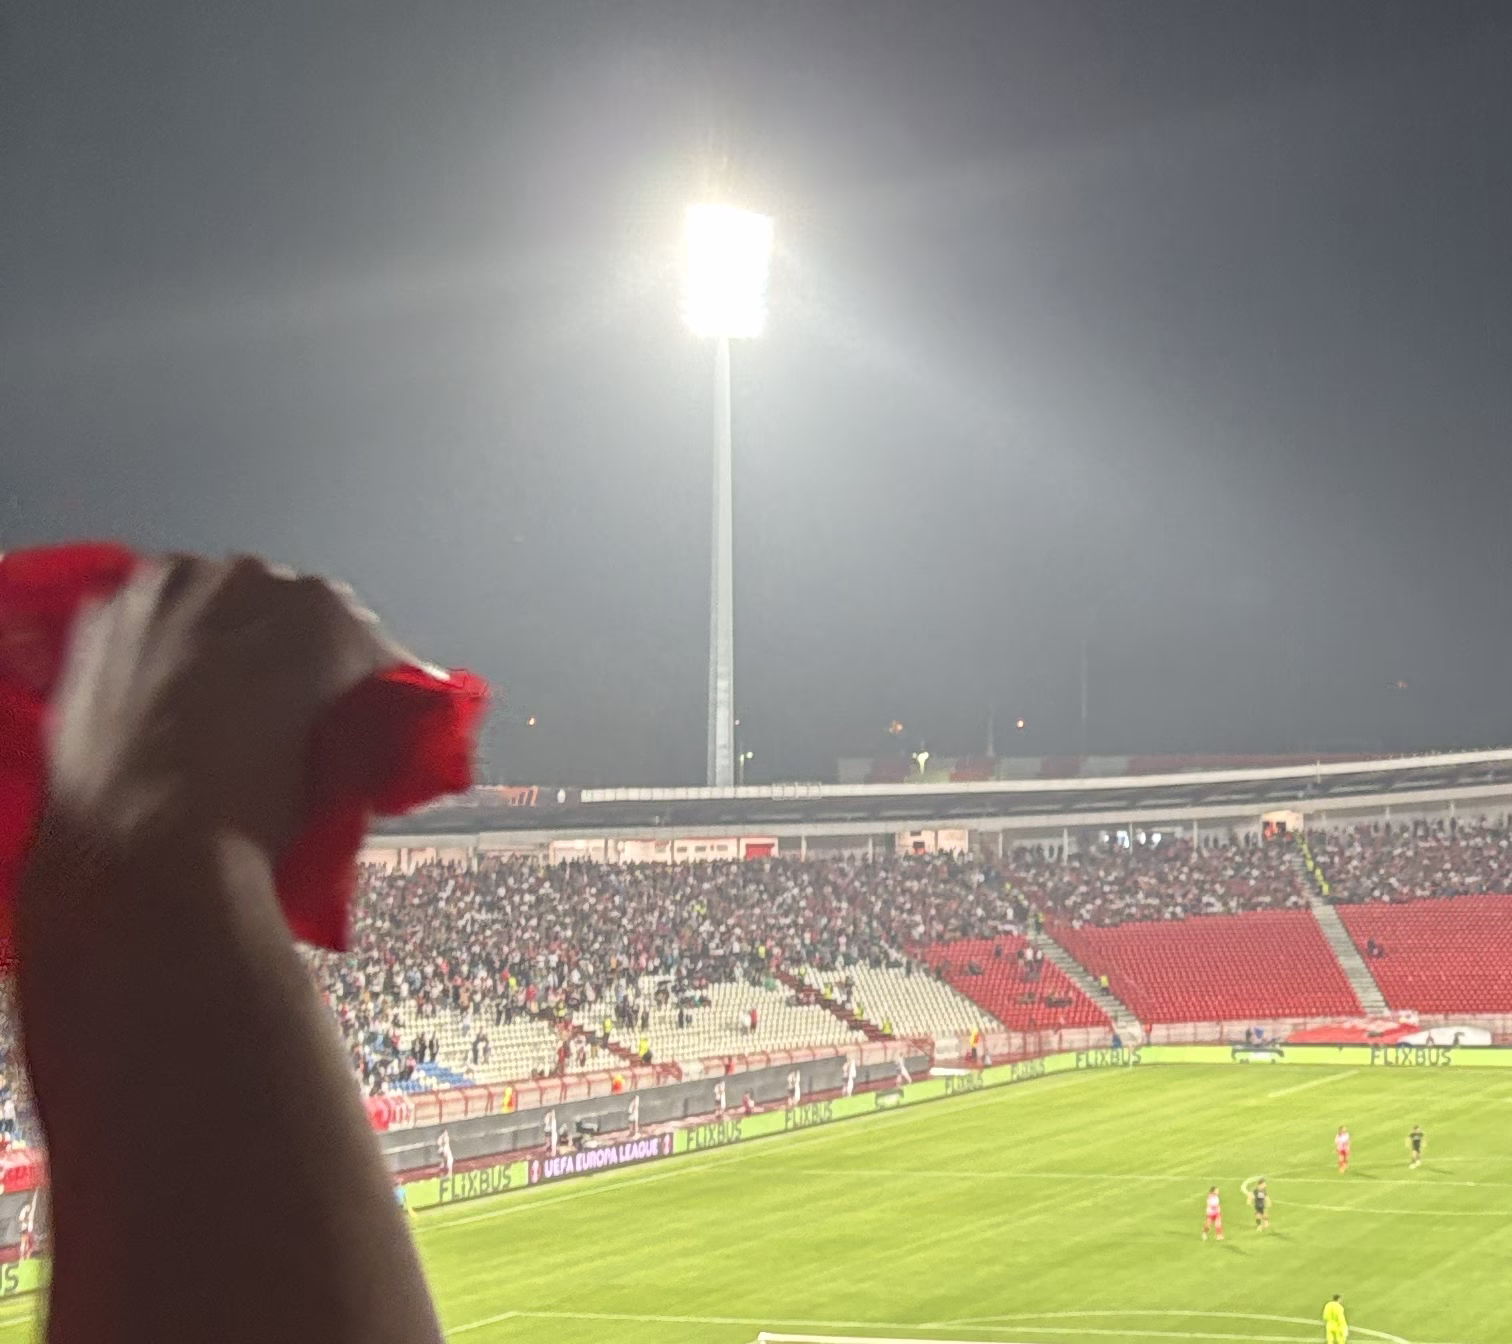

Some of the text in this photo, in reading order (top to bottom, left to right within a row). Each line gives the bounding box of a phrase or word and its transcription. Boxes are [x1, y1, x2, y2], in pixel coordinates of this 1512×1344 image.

[544, 1137, 659, 1178] UEFA EUROPA LEAGUE
